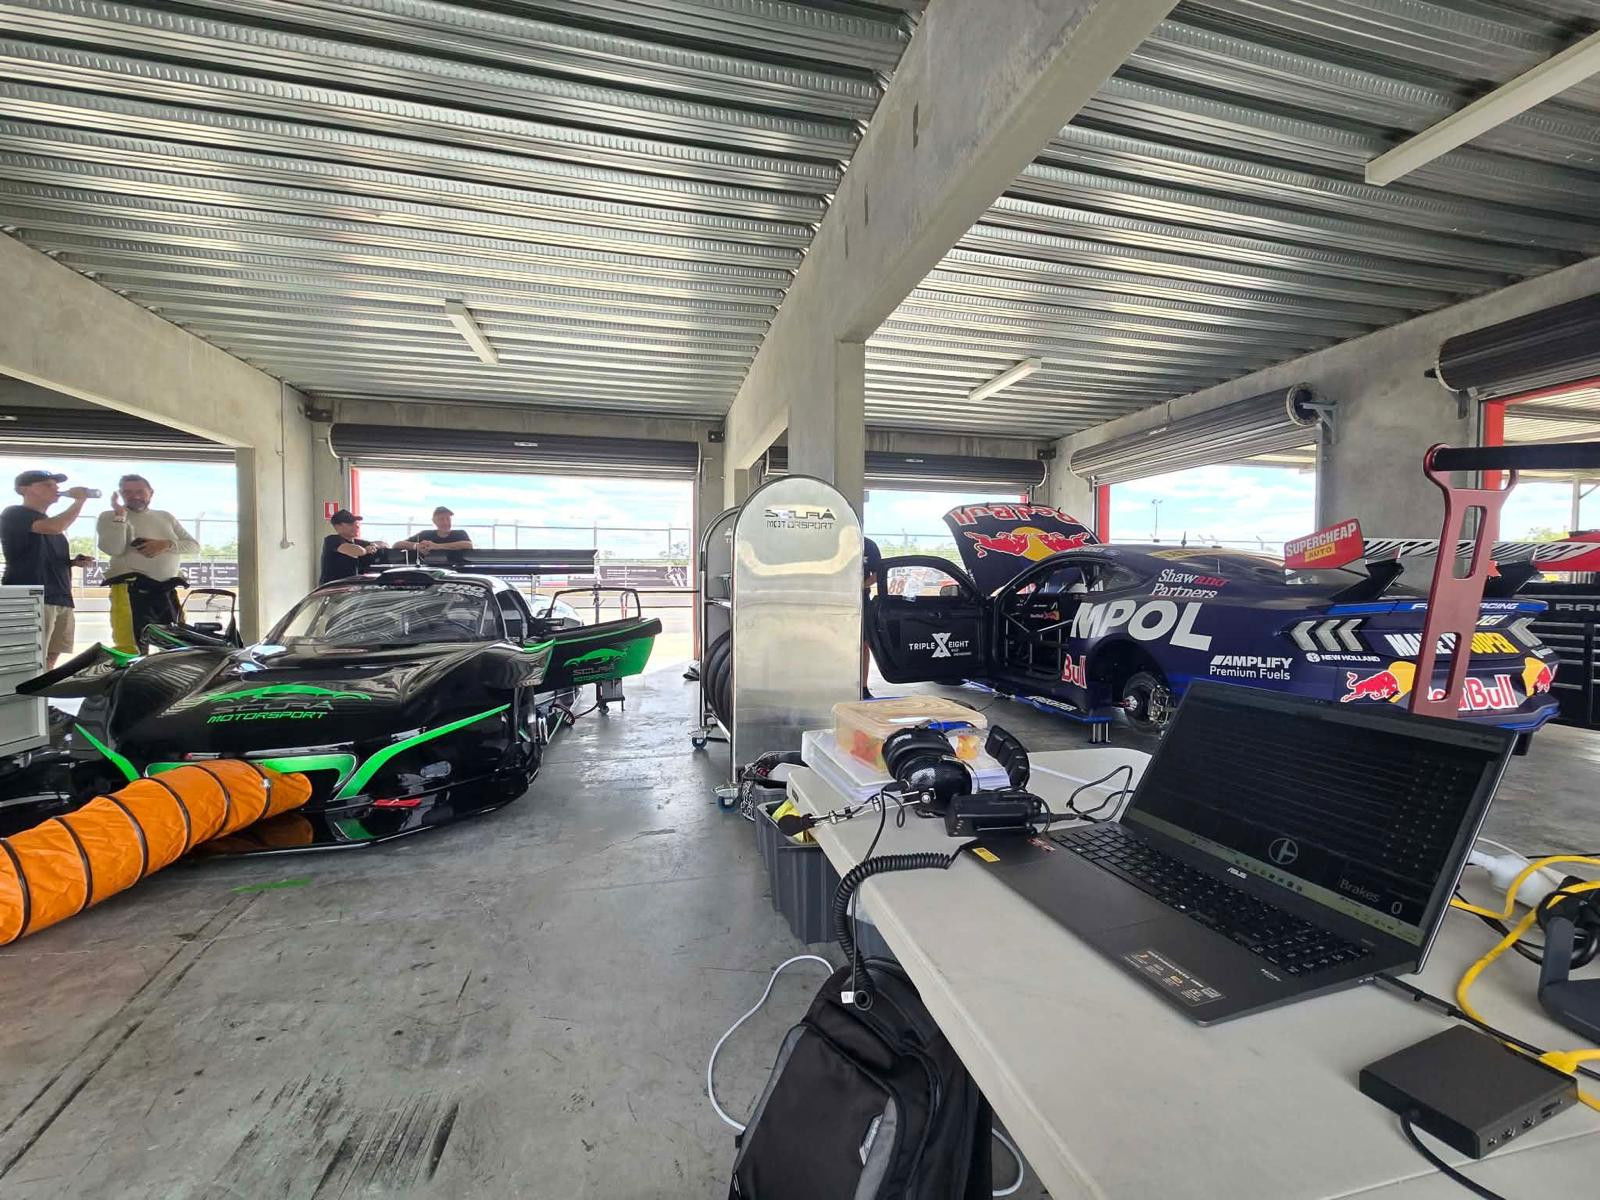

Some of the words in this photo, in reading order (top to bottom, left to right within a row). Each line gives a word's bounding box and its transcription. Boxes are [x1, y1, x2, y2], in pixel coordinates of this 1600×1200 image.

[766, 520, 834, 530] MOTORSPORT
[1286, 522, 1357, 557] SUPERCHEAP
[1307, 545, 1333, 559] AUTO
[1150, 583, 1218, 599] Partners
[908, 642, 936, 651] TRIPLE
[948, 640, 969, 648] EIGHT
[1222, 655, 1293, 669] AMPLIFY
[1320, 653, 1341, 662] NEW
[1341, 654, 1381, 663] HOLLAND
[1209, 666, 1257, 679] Premium
[1259, 670, 1291, 681] Fuels
[1464, 674, 1519, 711] Bull
[206, 711, 329, 724] MOTORSPORT
[1339, 878, 1381, 903] Brakes
